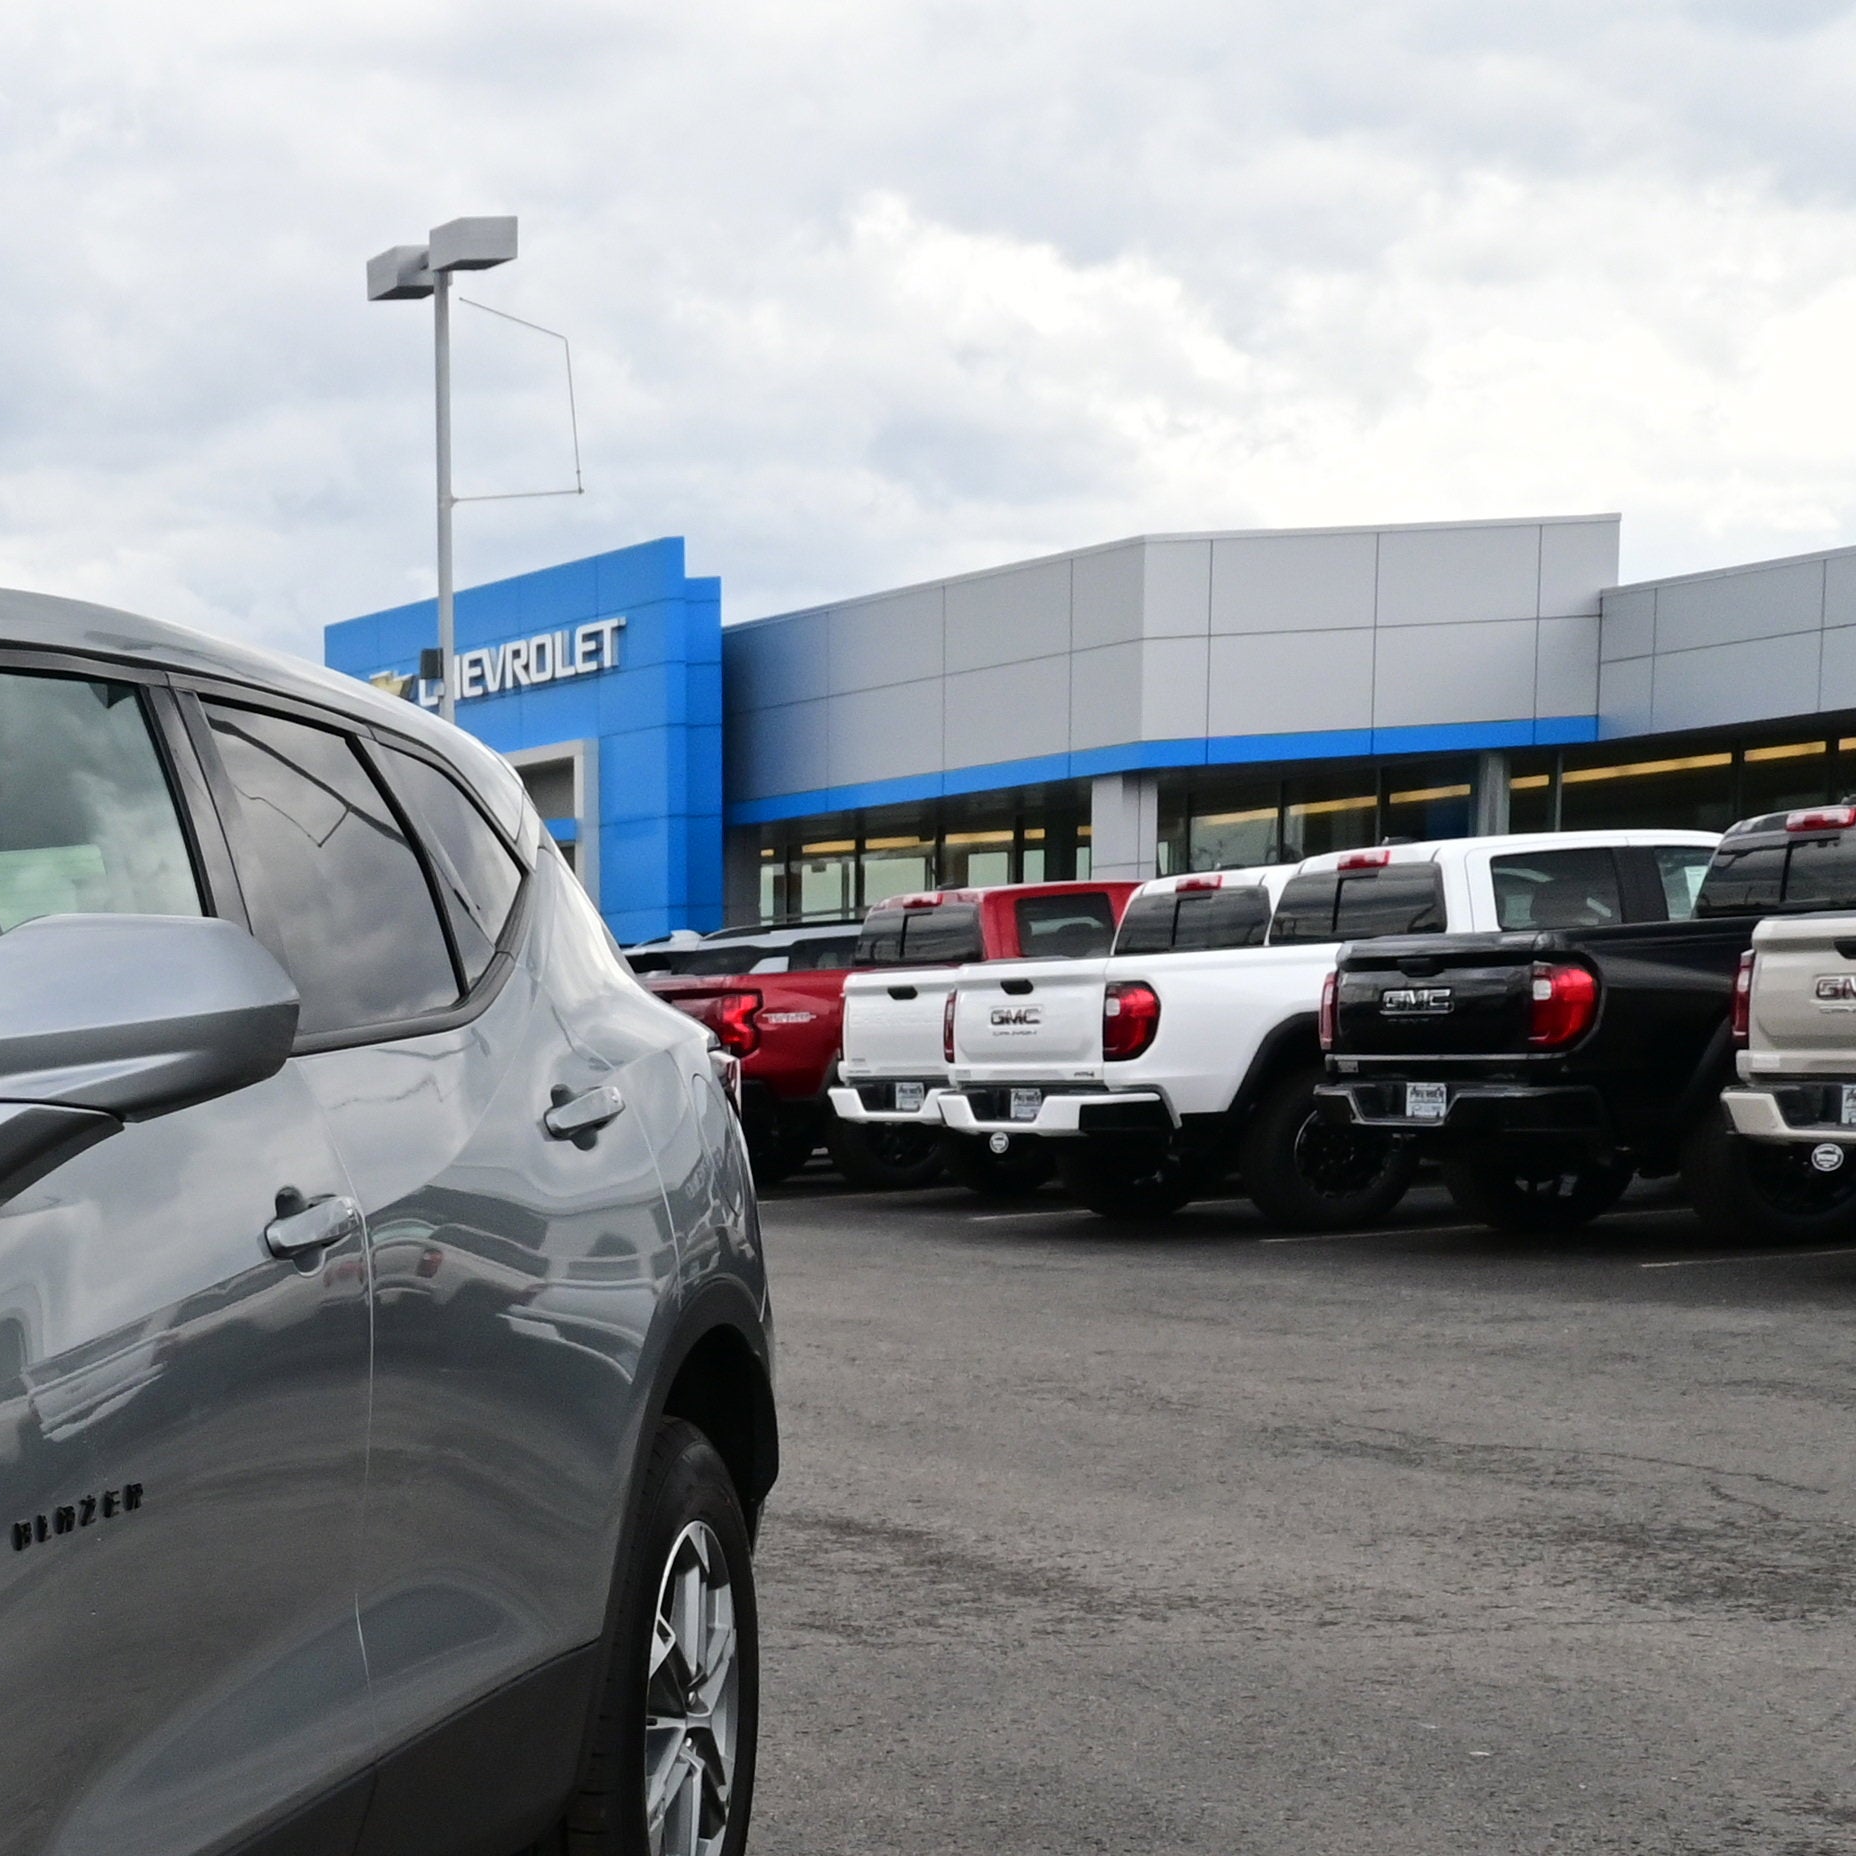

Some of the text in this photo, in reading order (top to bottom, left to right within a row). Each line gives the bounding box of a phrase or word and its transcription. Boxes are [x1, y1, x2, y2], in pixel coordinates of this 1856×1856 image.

[418, 618, 619, 707] EVROLET
[991, 1008, 1041, 1026] GMC
[1383, 988, 1451, 1011] GMC
[10, 1482, 145, 1552] BLAZER
